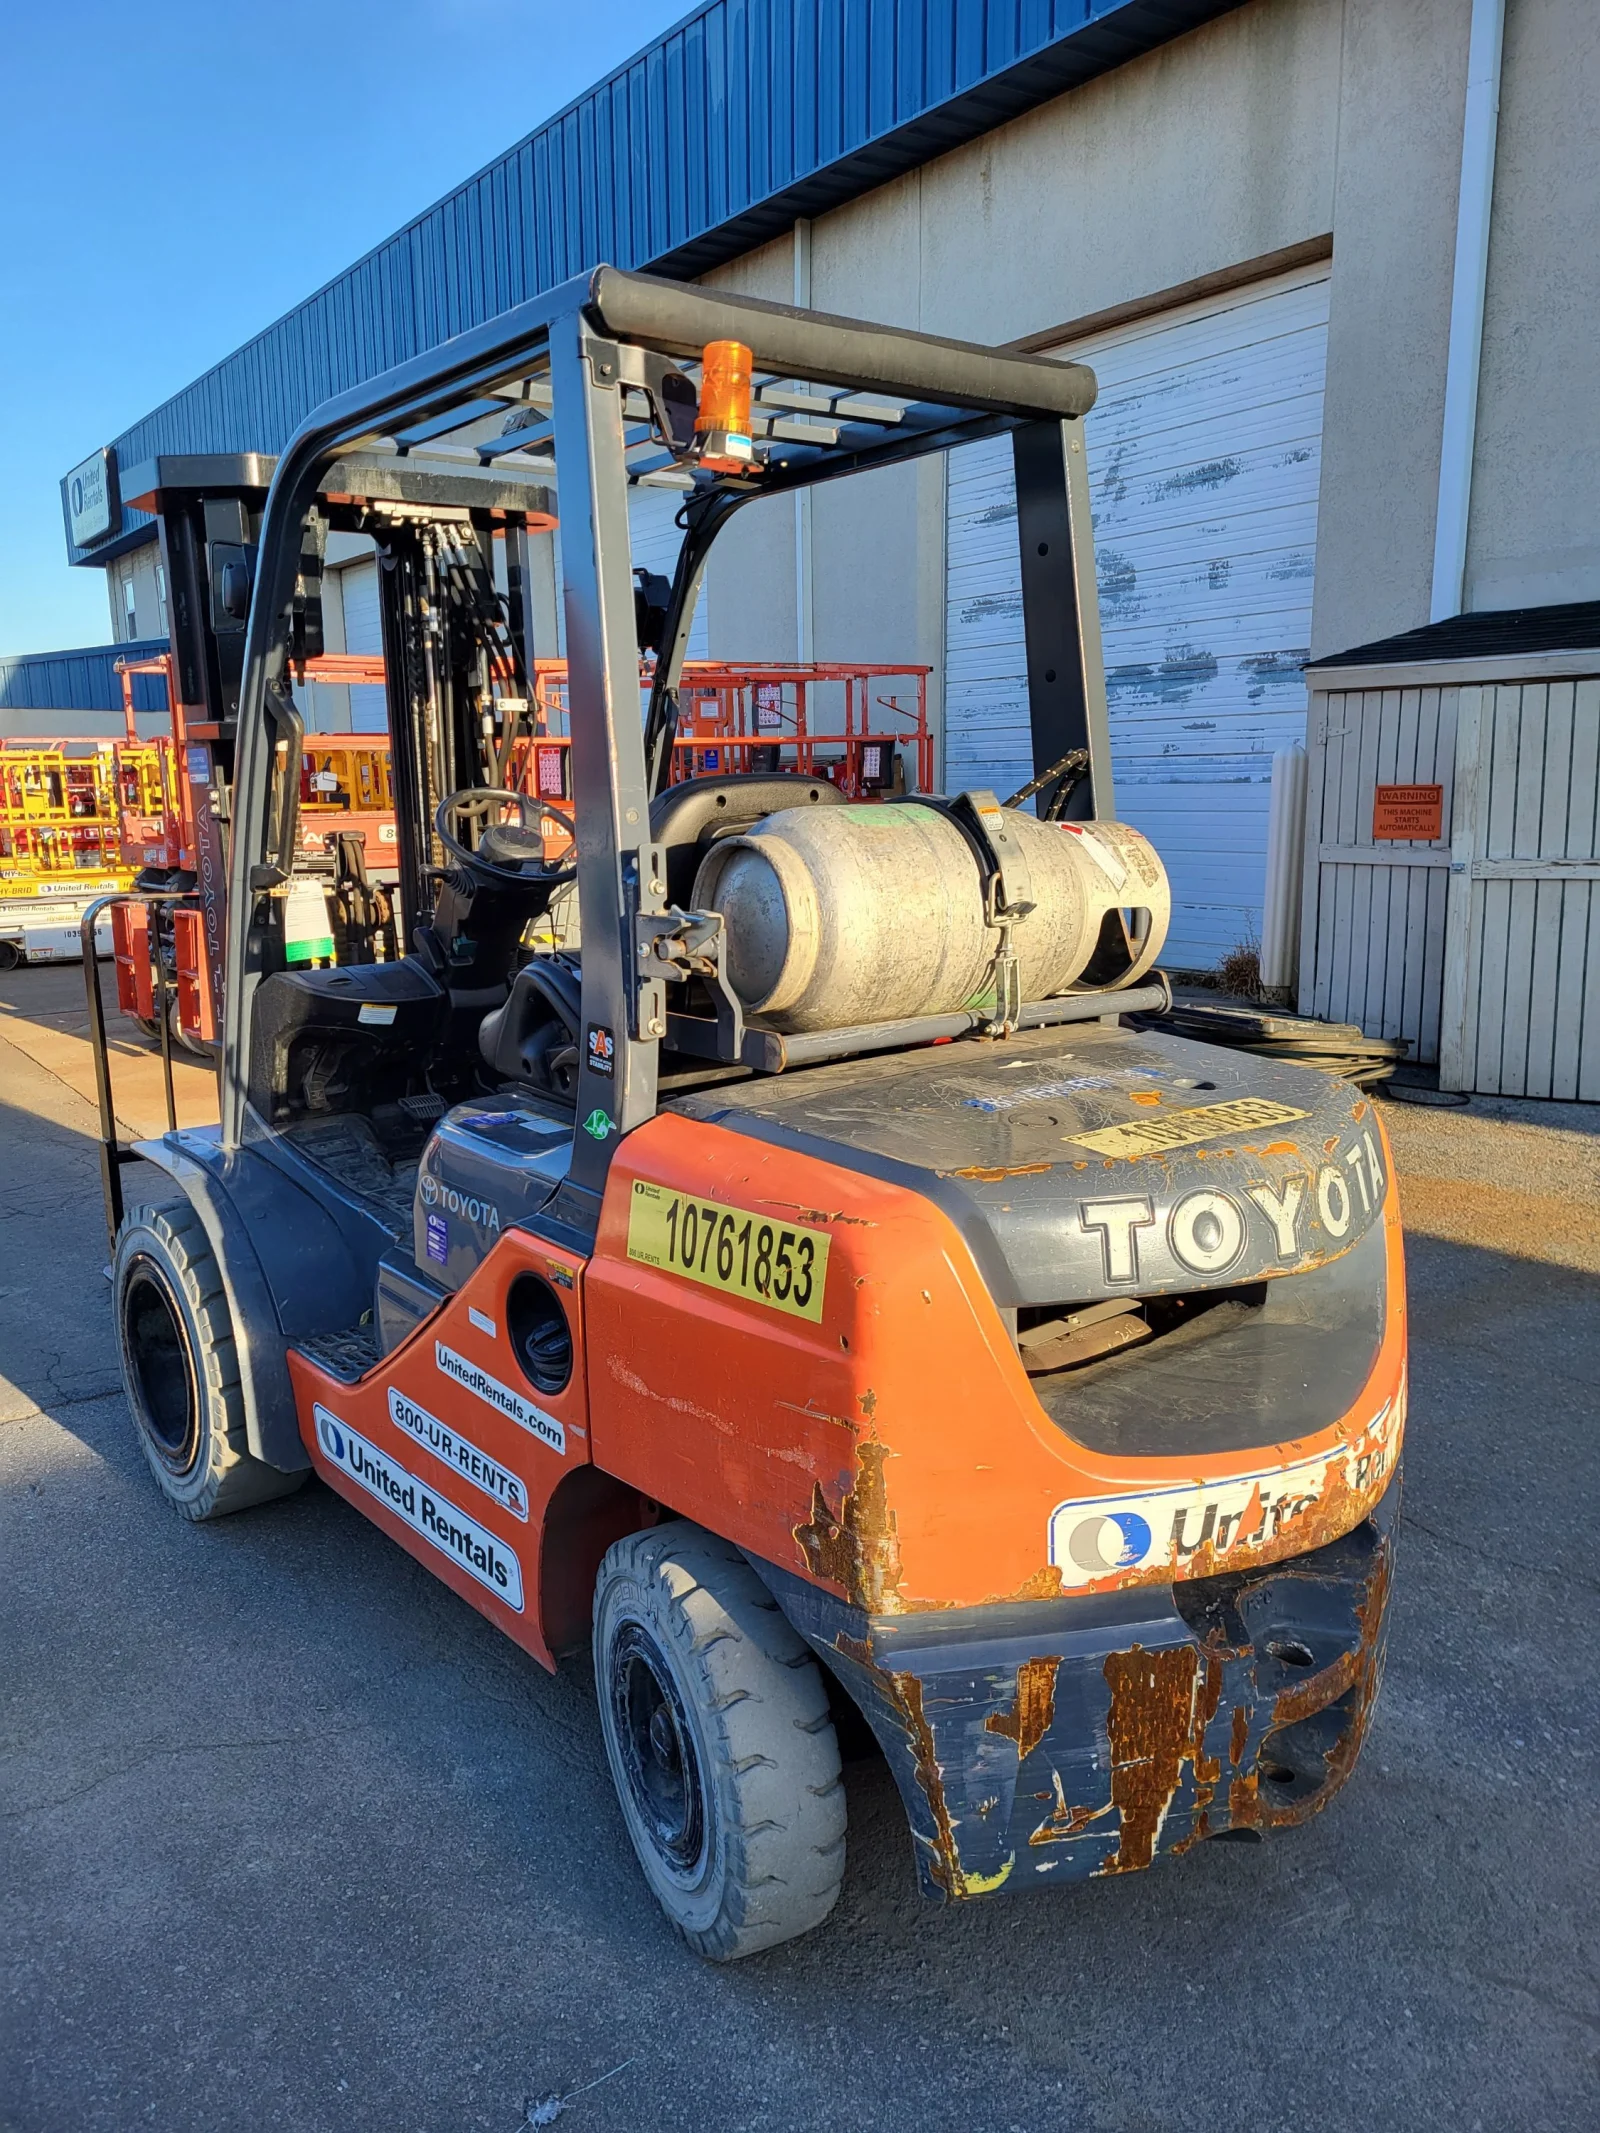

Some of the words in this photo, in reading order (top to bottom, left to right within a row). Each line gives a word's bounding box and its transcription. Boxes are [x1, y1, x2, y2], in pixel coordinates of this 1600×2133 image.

[82, 462, 100, 491] United
[83, 486, 103, 512] Rentals
[1381, 791, 1436, 801] WARNING
[1383, 808, 1399, 816] THIS
[1400, 808, 1432, 816] MACHINE
[1394, 816, 1420, 824] STARTS
[1378, 824, 1436, 832] AUTOMATICALLY
[53, 884, 82, 892] United
[84, 882, 114, 890] Rentals
[197, 803, 220, 956] TOYOTA
[589, 1030, 613, 1058] SAS
[440, 1185, 500, 1232] TOYOTA
[1080, 1131, 1384, 1284] TOYOTA
[666, 1198, 815, 1308] 10761853
[438, 1348, 562, 1447] UnitedRentals.com
[395, 1400, 521, 1502] 800-UR-RENTS
[348, 1439, 416, 1516] United
[421, 1494, 509, 1588] Rentals
